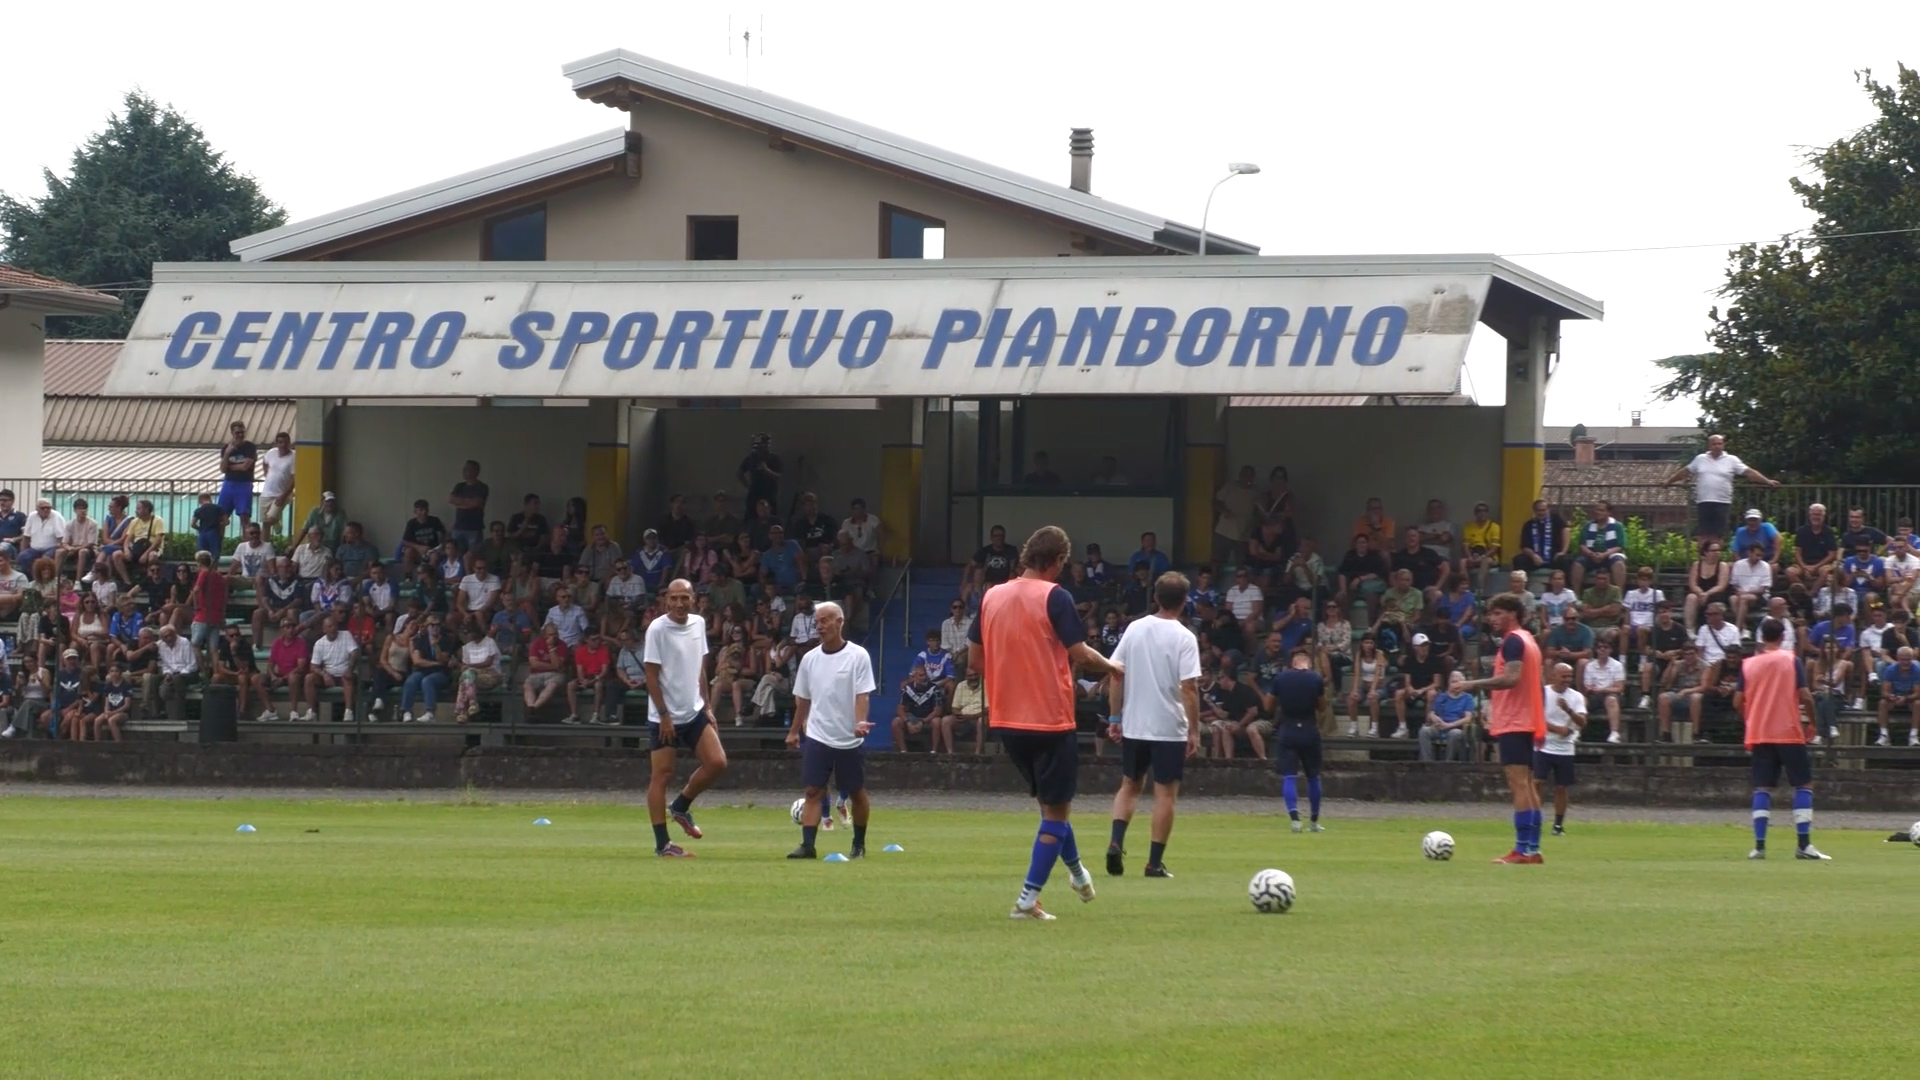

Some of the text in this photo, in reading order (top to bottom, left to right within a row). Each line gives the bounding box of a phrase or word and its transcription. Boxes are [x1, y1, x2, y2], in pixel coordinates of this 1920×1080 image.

[163, 304, 1409, 370] CENTRO SPORTIVO PIANBORNO
